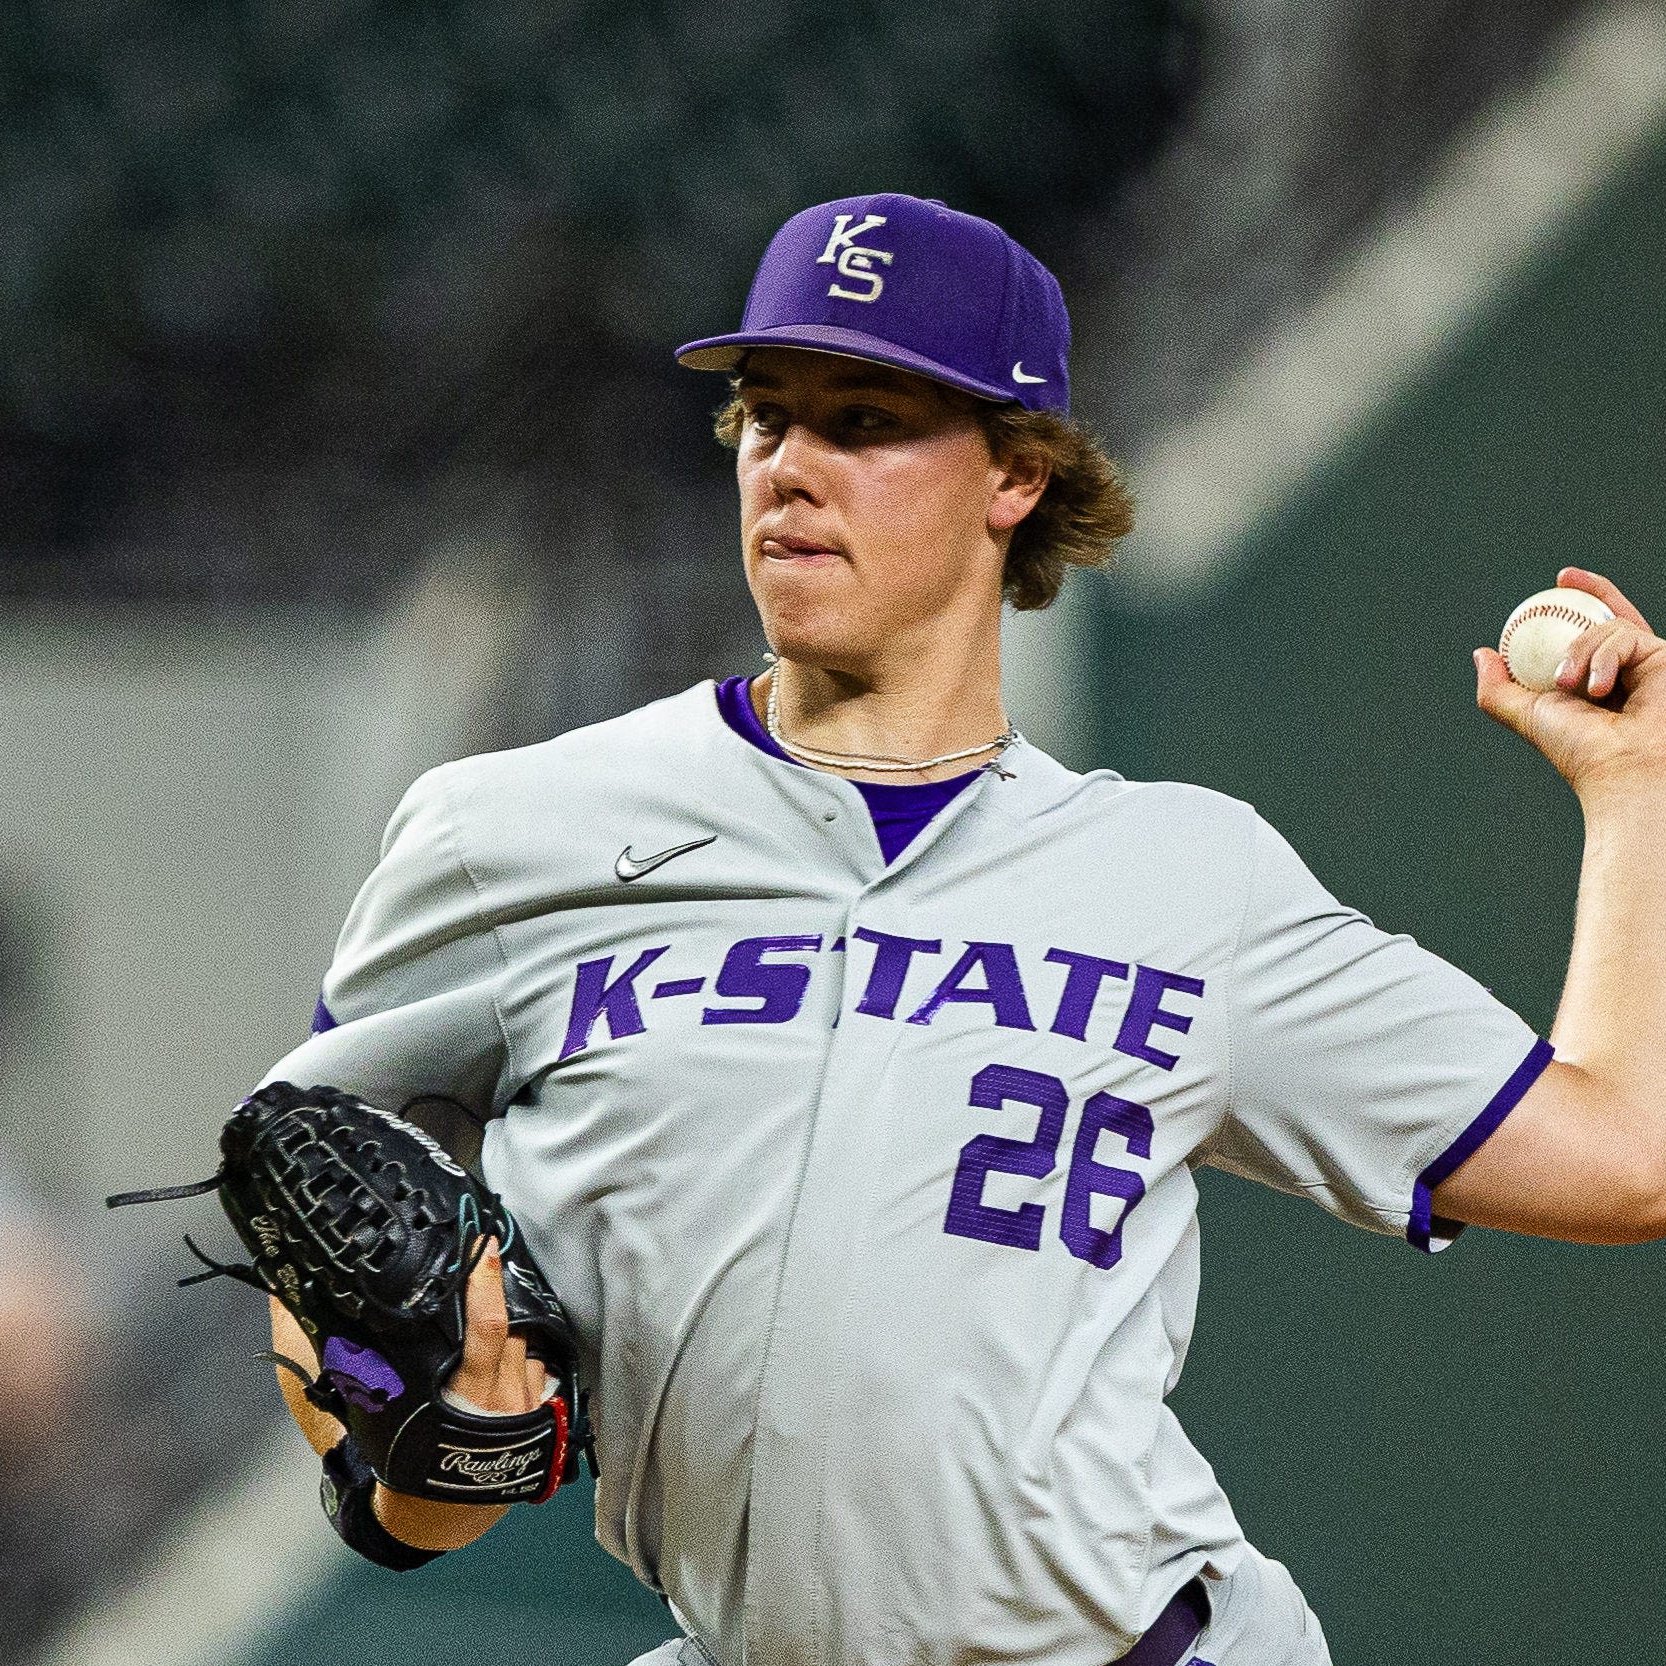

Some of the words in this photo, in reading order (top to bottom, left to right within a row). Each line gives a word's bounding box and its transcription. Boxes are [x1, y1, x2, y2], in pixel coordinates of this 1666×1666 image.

[557, 925, 1206, 1072] K-STATE
[942, 1063, 1155, 1271] 26
[439, 1447, 543, 1476] Rawlings
